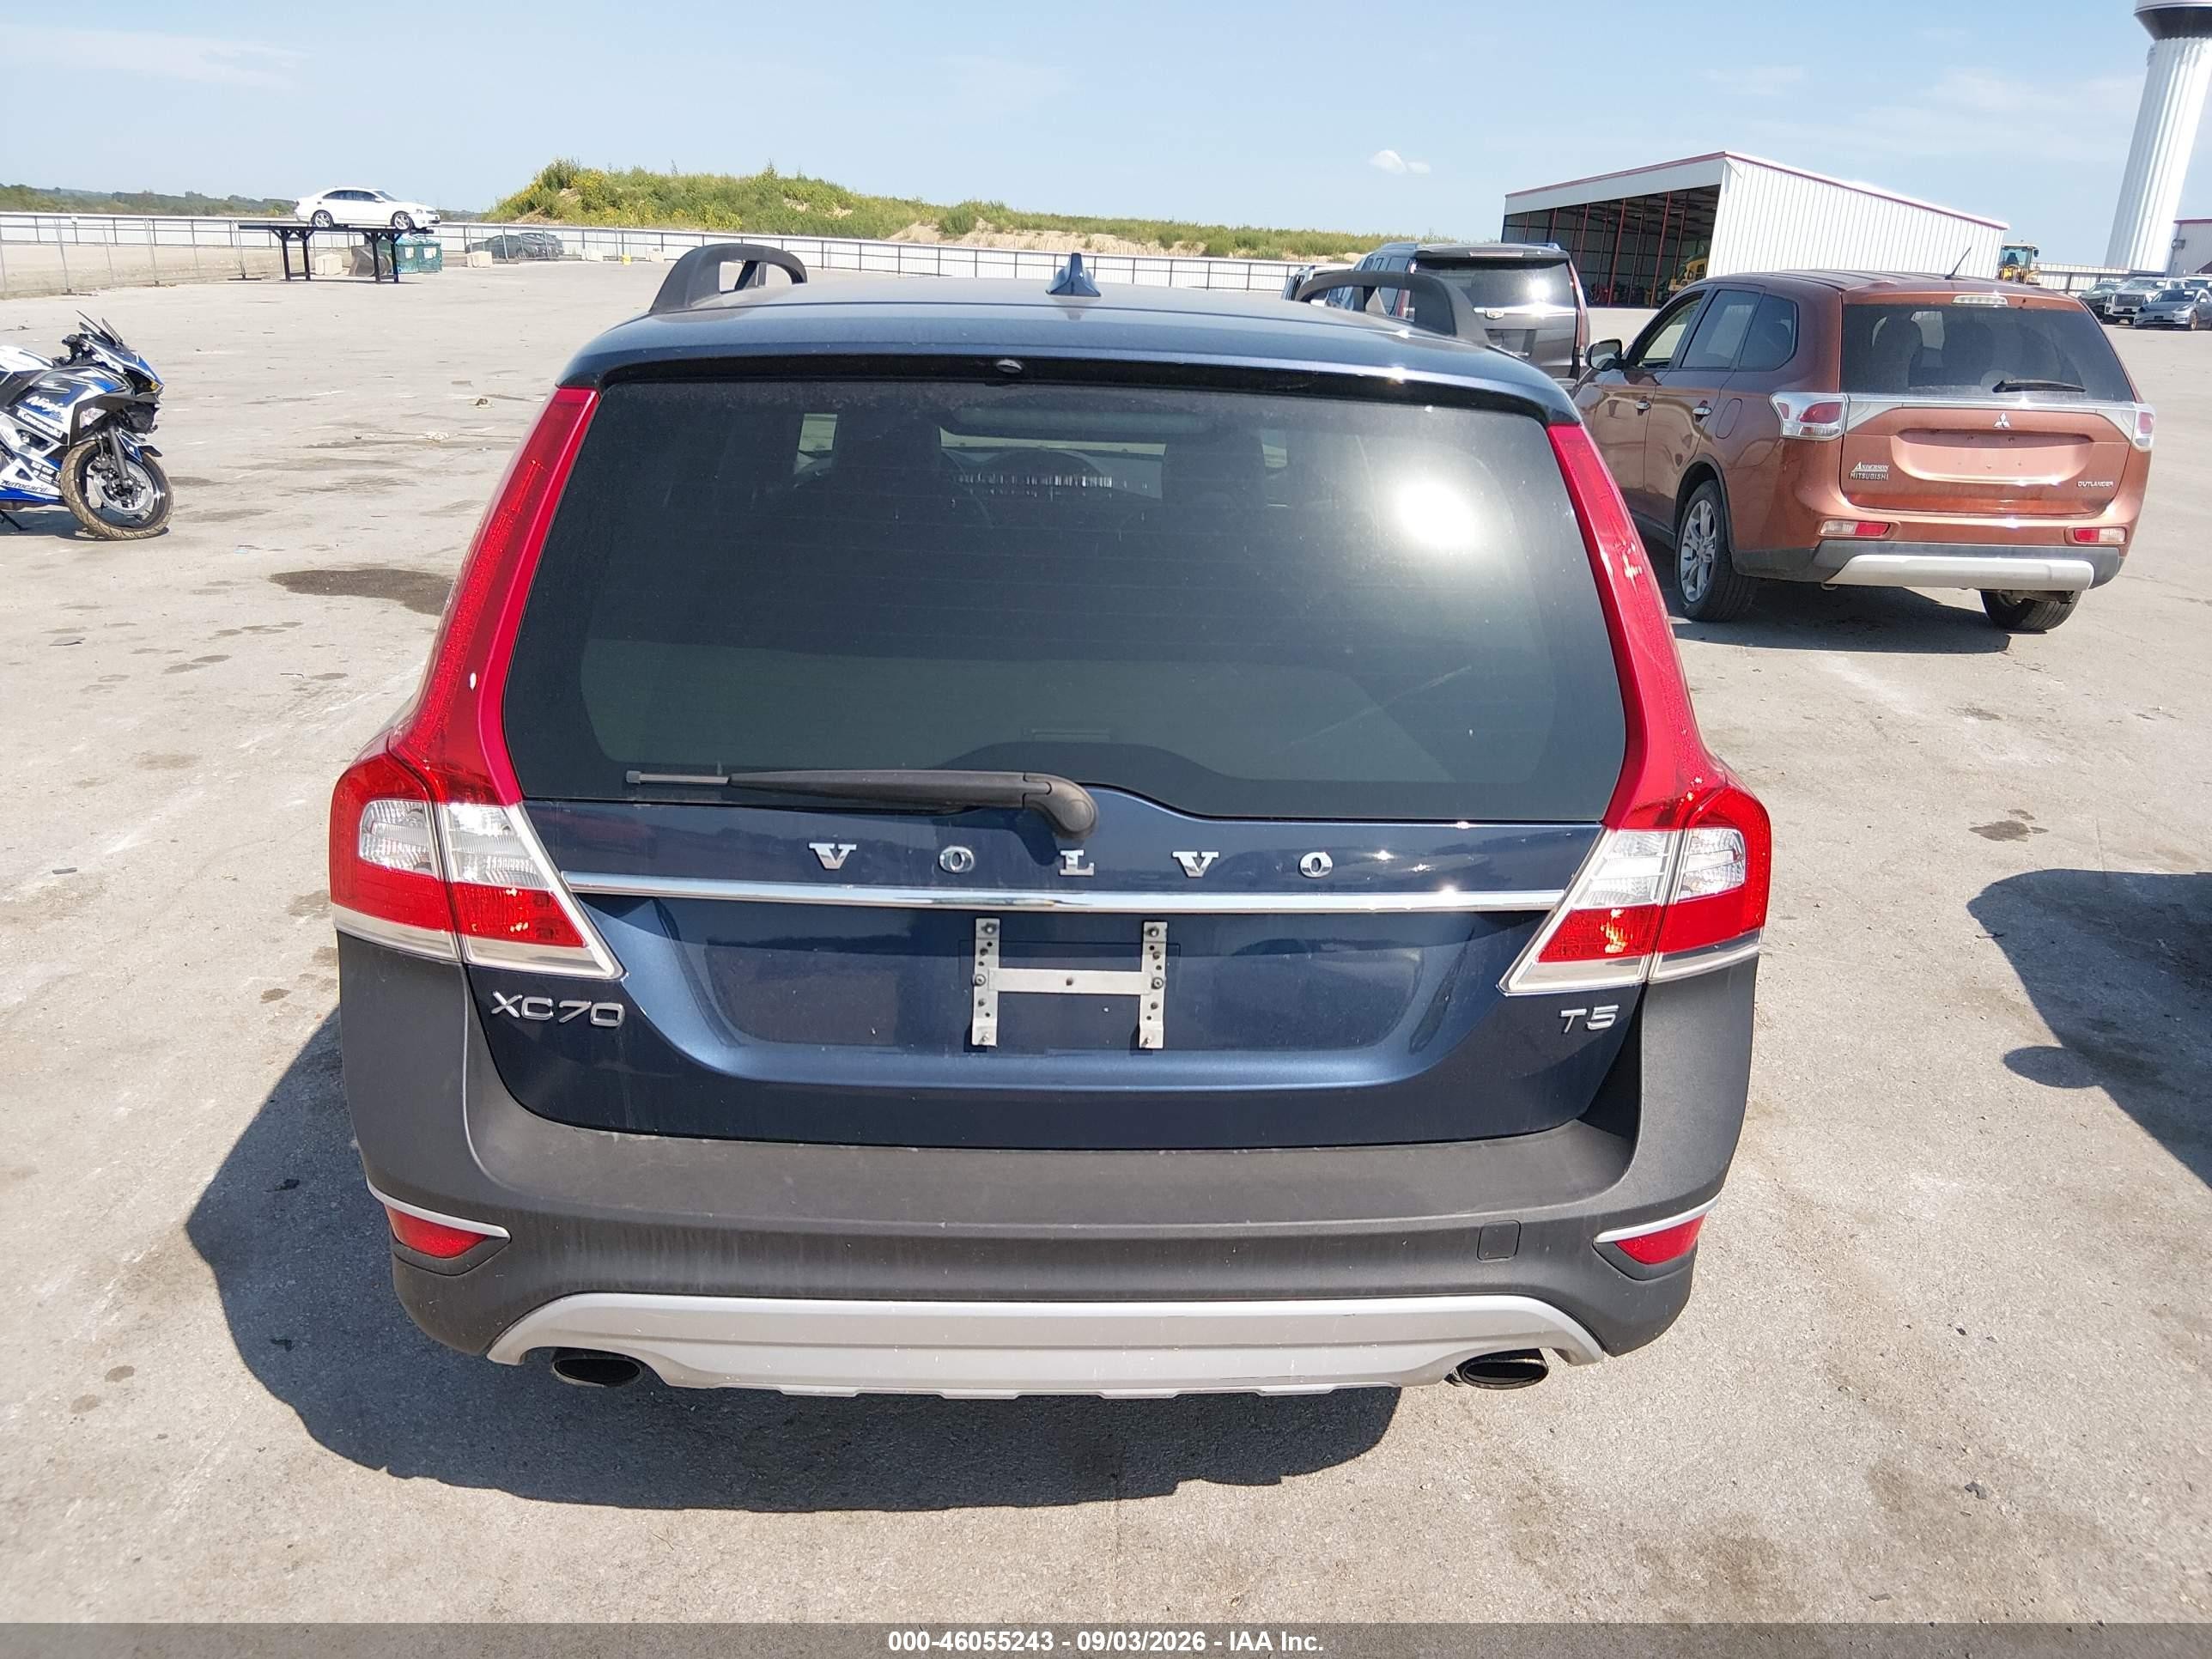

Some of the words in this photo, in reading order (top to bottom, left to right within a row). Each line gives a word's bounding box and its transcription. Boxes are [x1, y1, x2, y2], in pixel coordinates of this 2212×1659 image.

[17, 408, 64, 439] Kawasaki
[809, 842, 1333, 878] VOLVO
[491, 990, 625, 1027] XC70
[1560, 1004, 1620, 1033] T5
